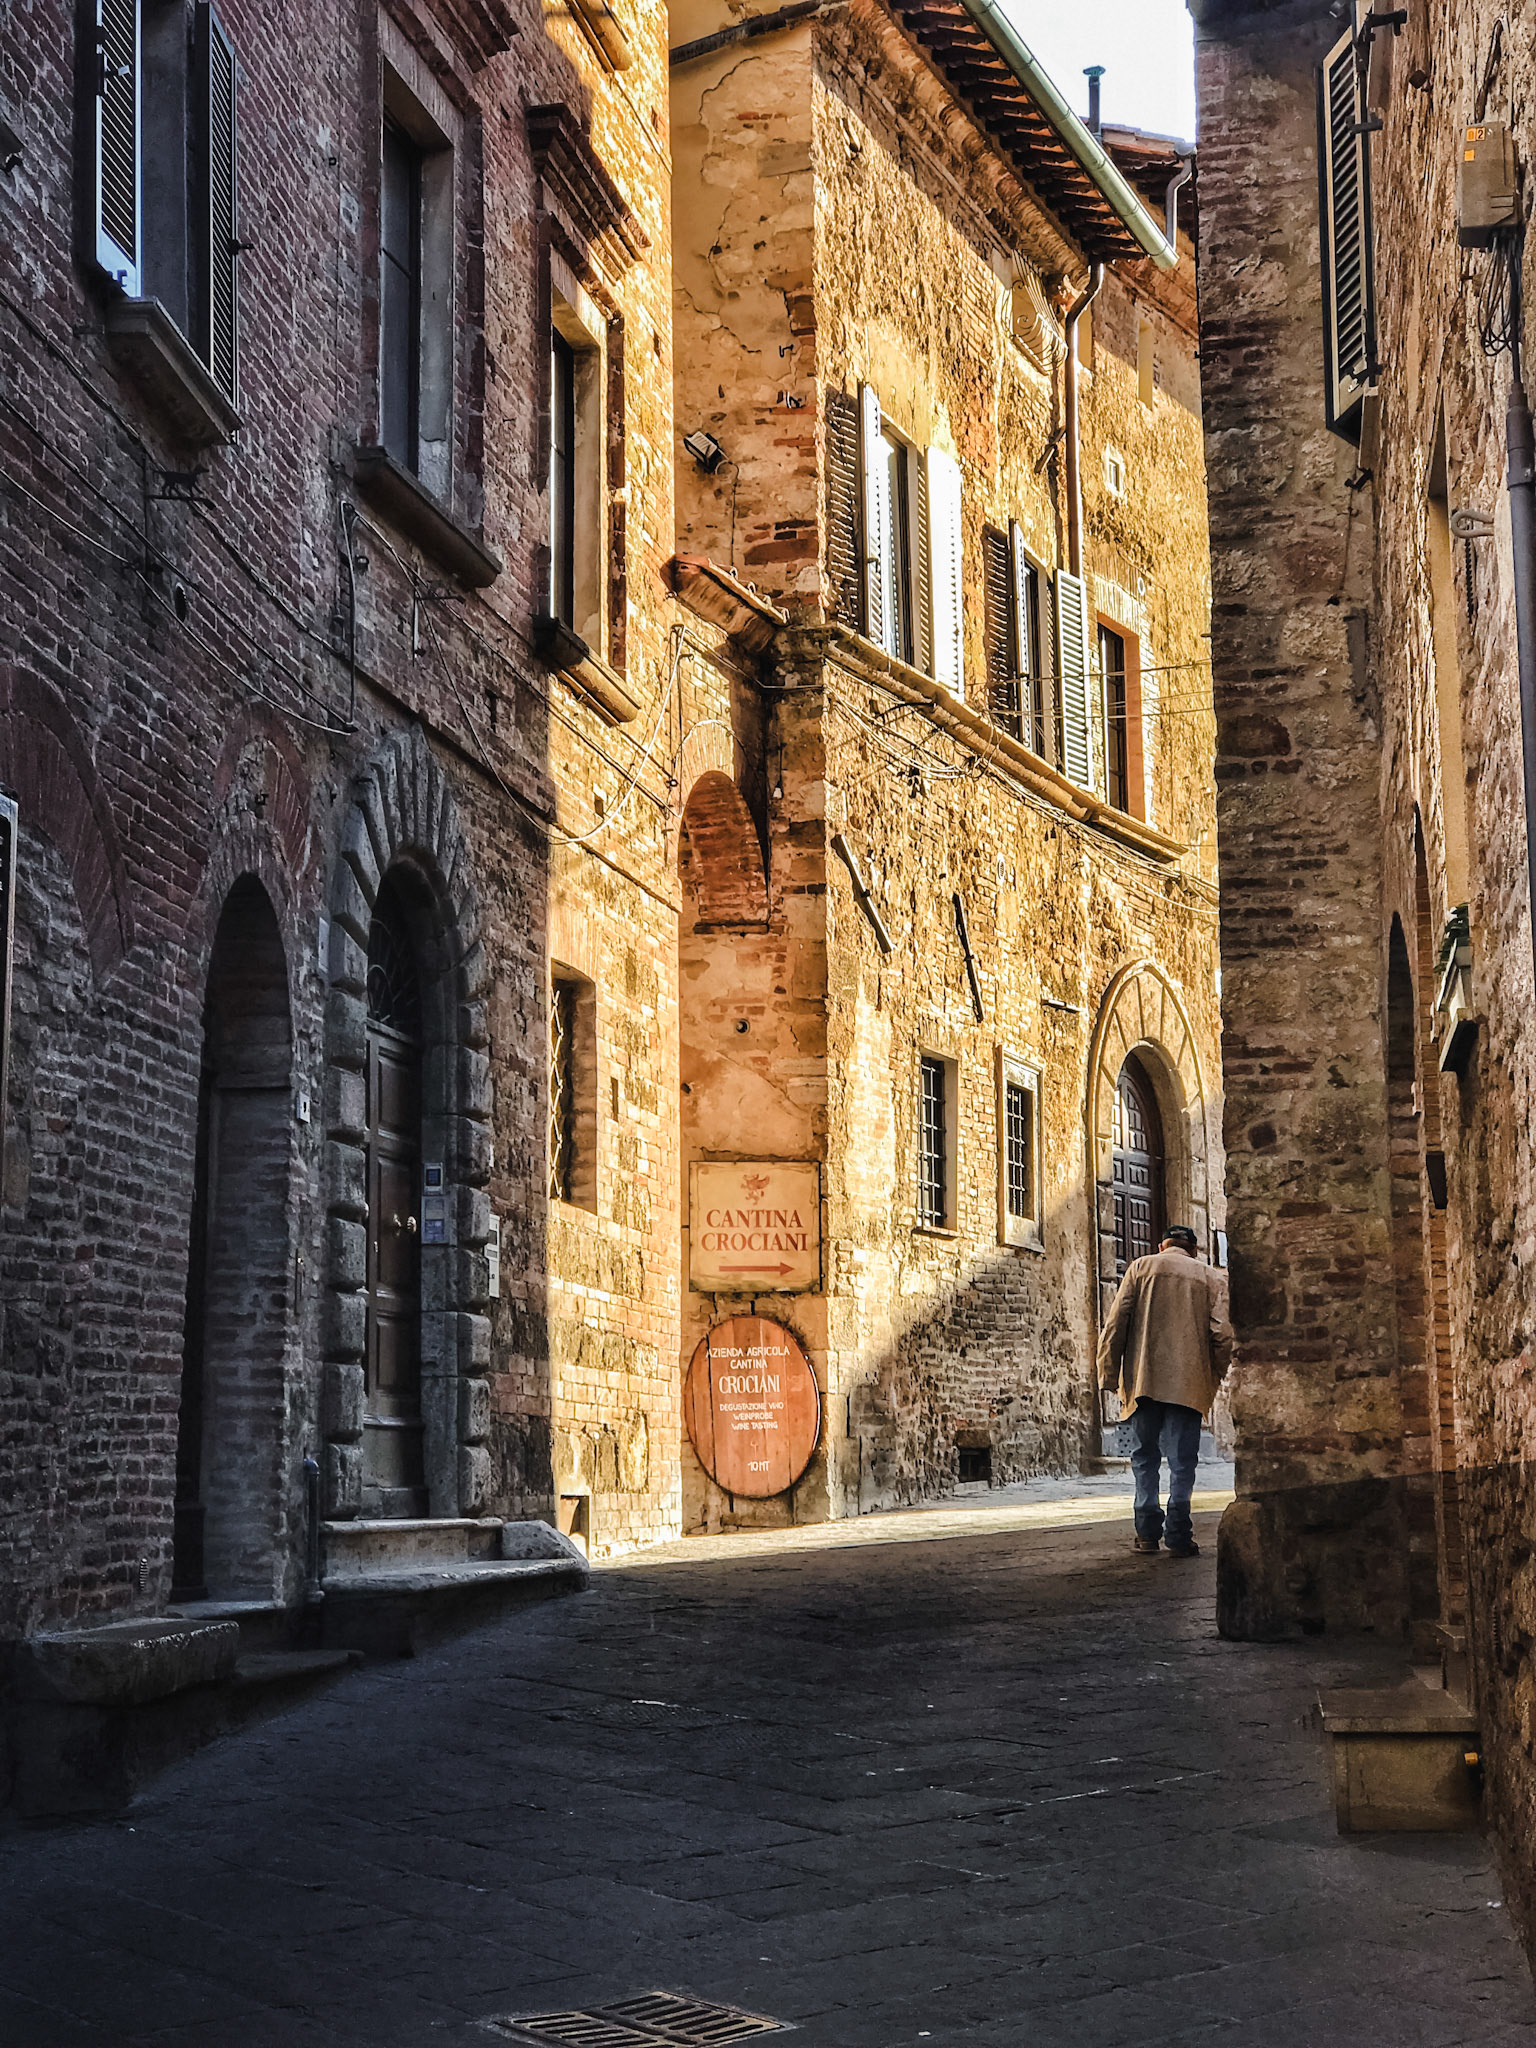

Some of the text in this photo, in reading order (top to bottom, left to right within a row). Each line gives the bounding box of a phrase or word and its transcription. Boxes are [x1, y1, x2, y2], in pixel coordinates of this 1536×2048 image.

[706, 1209, 804, 1228] CANTINA
[701, 1232, 809, 1251] CROCIANI
[706, 1346, 790, 1358] AZIENDA AGRICOLA
[730, 1359, 768, 1370] CANTINA
[718, 1375, 780, 1394] CROCIANI
[719, 1402, 767, 1411] DEGUSTAZIONE
[732, 1411, 773, 1420] WEINPROBE
[731, 1421, 778, 1431] WINE TASTING
